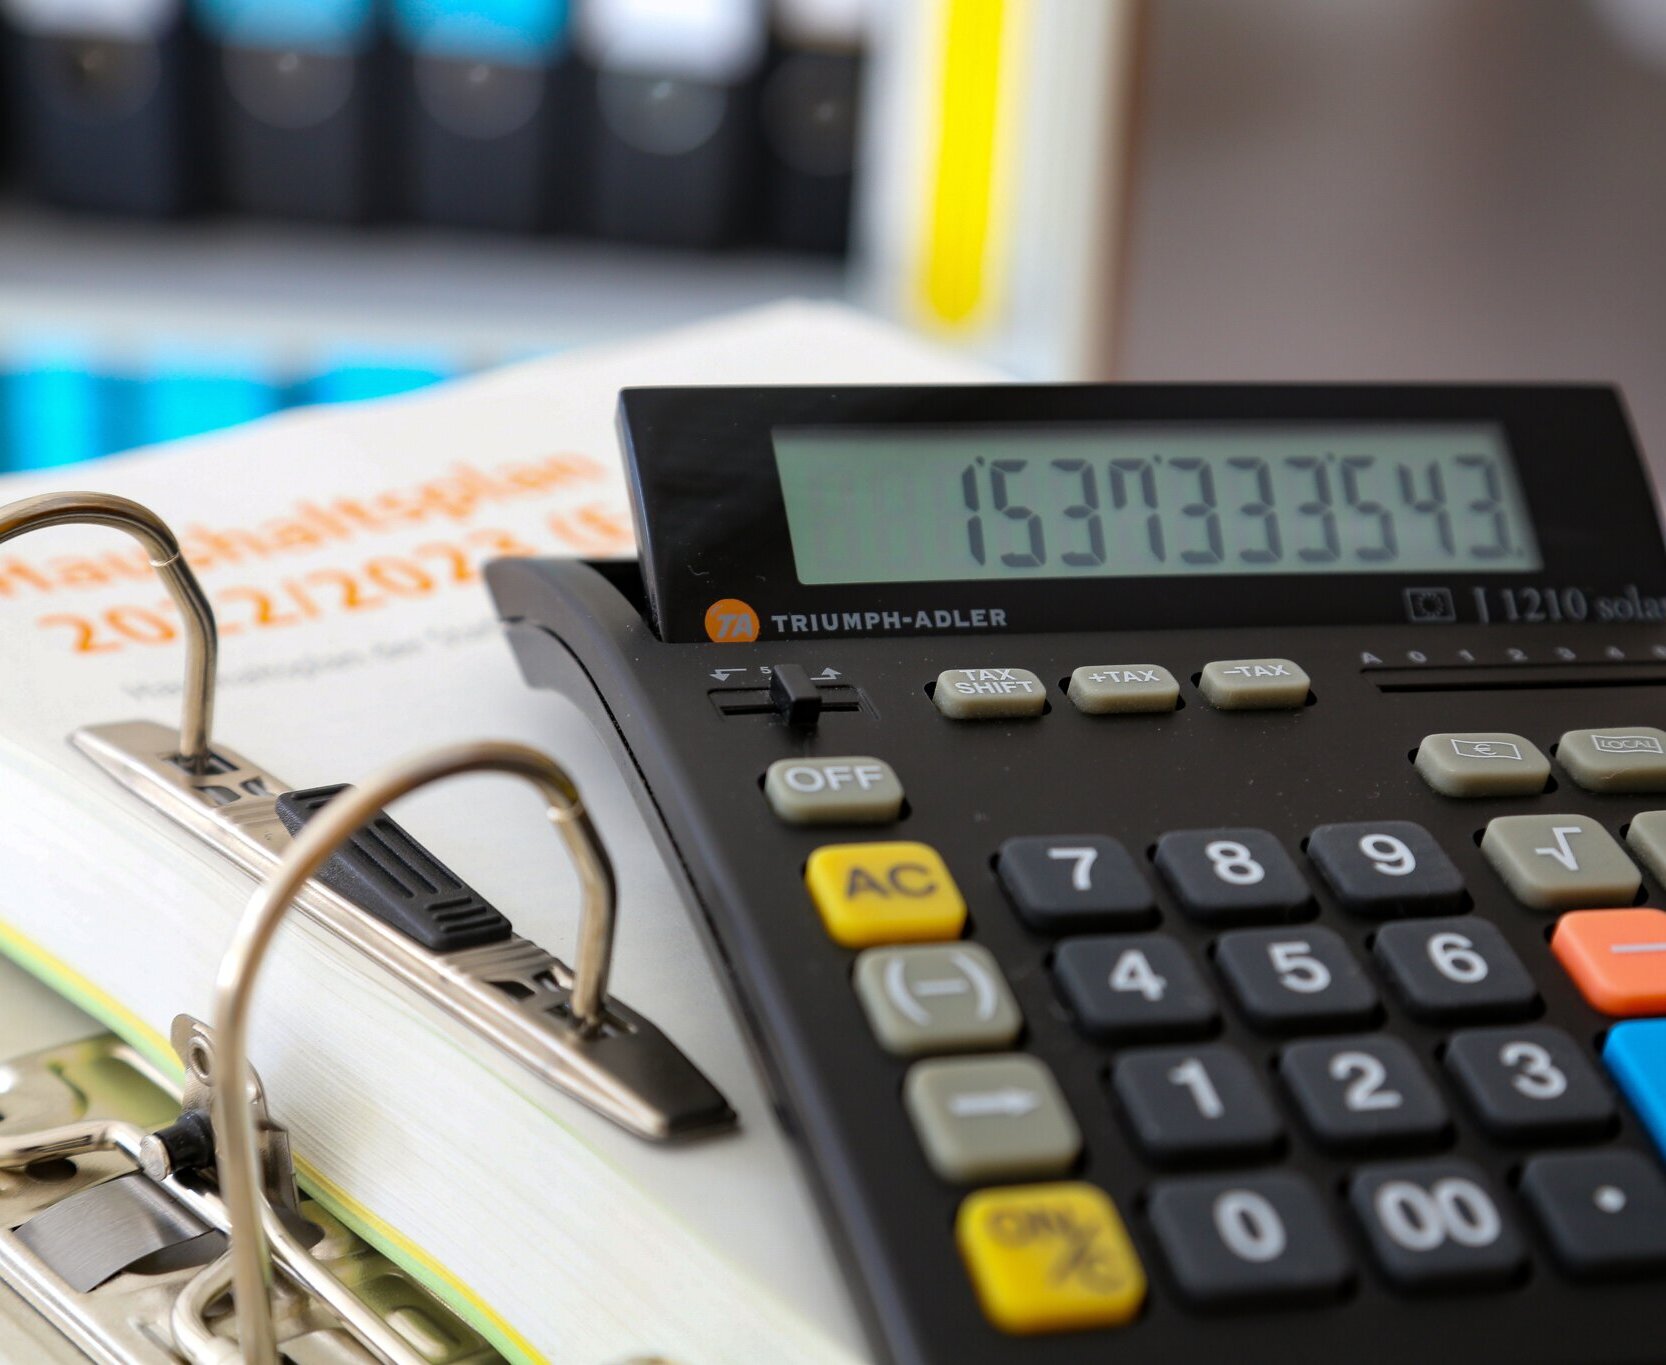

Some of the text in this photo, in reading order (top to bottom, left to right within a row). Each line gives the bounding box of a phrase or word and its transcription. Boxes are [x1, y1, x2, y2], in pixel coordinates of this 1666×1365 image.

[715, 612, 752, 638] TA
[771, 608, 1007, 633] TRIUMPH-ADLER
[1502, 587, 1588, 622] 1210
[958, 669, 1012, 682] TAX
[1088, 670, 1160, 683] +TAX
[1361, 652, 1382, 664] A
[1408, 650, 1427, 663] 0
[1459, 649, 1475, 661] 1
[1508, 648, 1528, 661] 2
[957, 681, 1033, 694] SHIFT
[1601, 739, 1657, 750] LOCAL
[785, 765, 882, 792] OFF
[1049, 847, 1098, 890] 7
[1206, 840, 1265, 885] 8
[1359, 833, 1416, 876] 9
[846, 864, 937, 900] AC
[1110, 950, 1166, 1001] 4
[1268, 941, 1331, 992] 5
[1427, 933, 1488, 982] 6
[1168, 1058, 1223, 1118] 1
[1329, 1051, 1402, 1110] 2
[1501, 1041, 1567, 1098] 3
[1214, 1189, 1286, 1262] 0
[1375, 1178, 1501, 1250] 00
